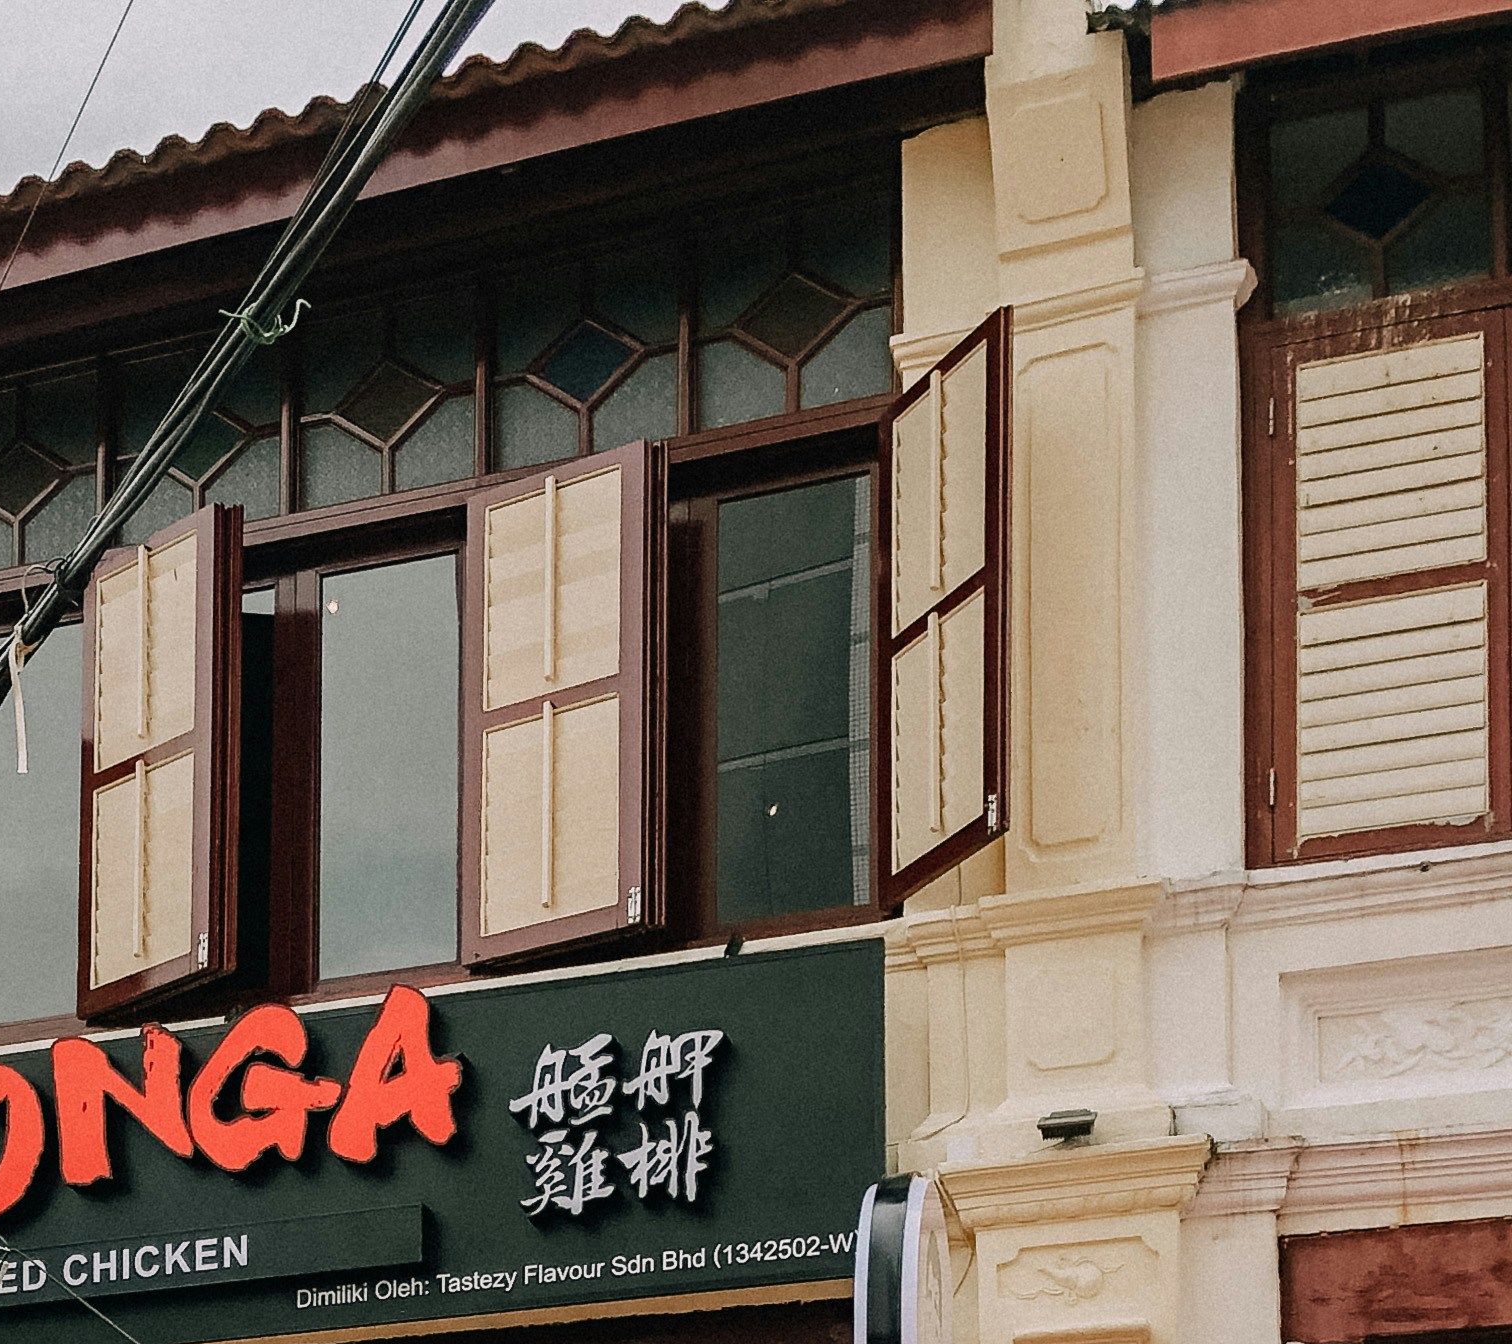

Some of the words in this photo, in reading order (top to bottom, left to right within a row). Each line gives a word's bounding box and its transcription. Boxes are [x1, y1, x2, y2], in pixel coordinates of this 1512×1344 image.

[508, 1029, 724, 1129] 艋舺
[63, 1235, 249, 1286] CHICKEN
[296, 1282, 368, 1309] Dimiliki
[375, 1278, 429, 1300] Oleh:
[436, 1271, 517, 1292] Tastezy
[524, 1261, 605, 1284] Flavour
[611, 1254, 655, 1276] Sdn
[662, 1248, 706, 1271] Bhd
